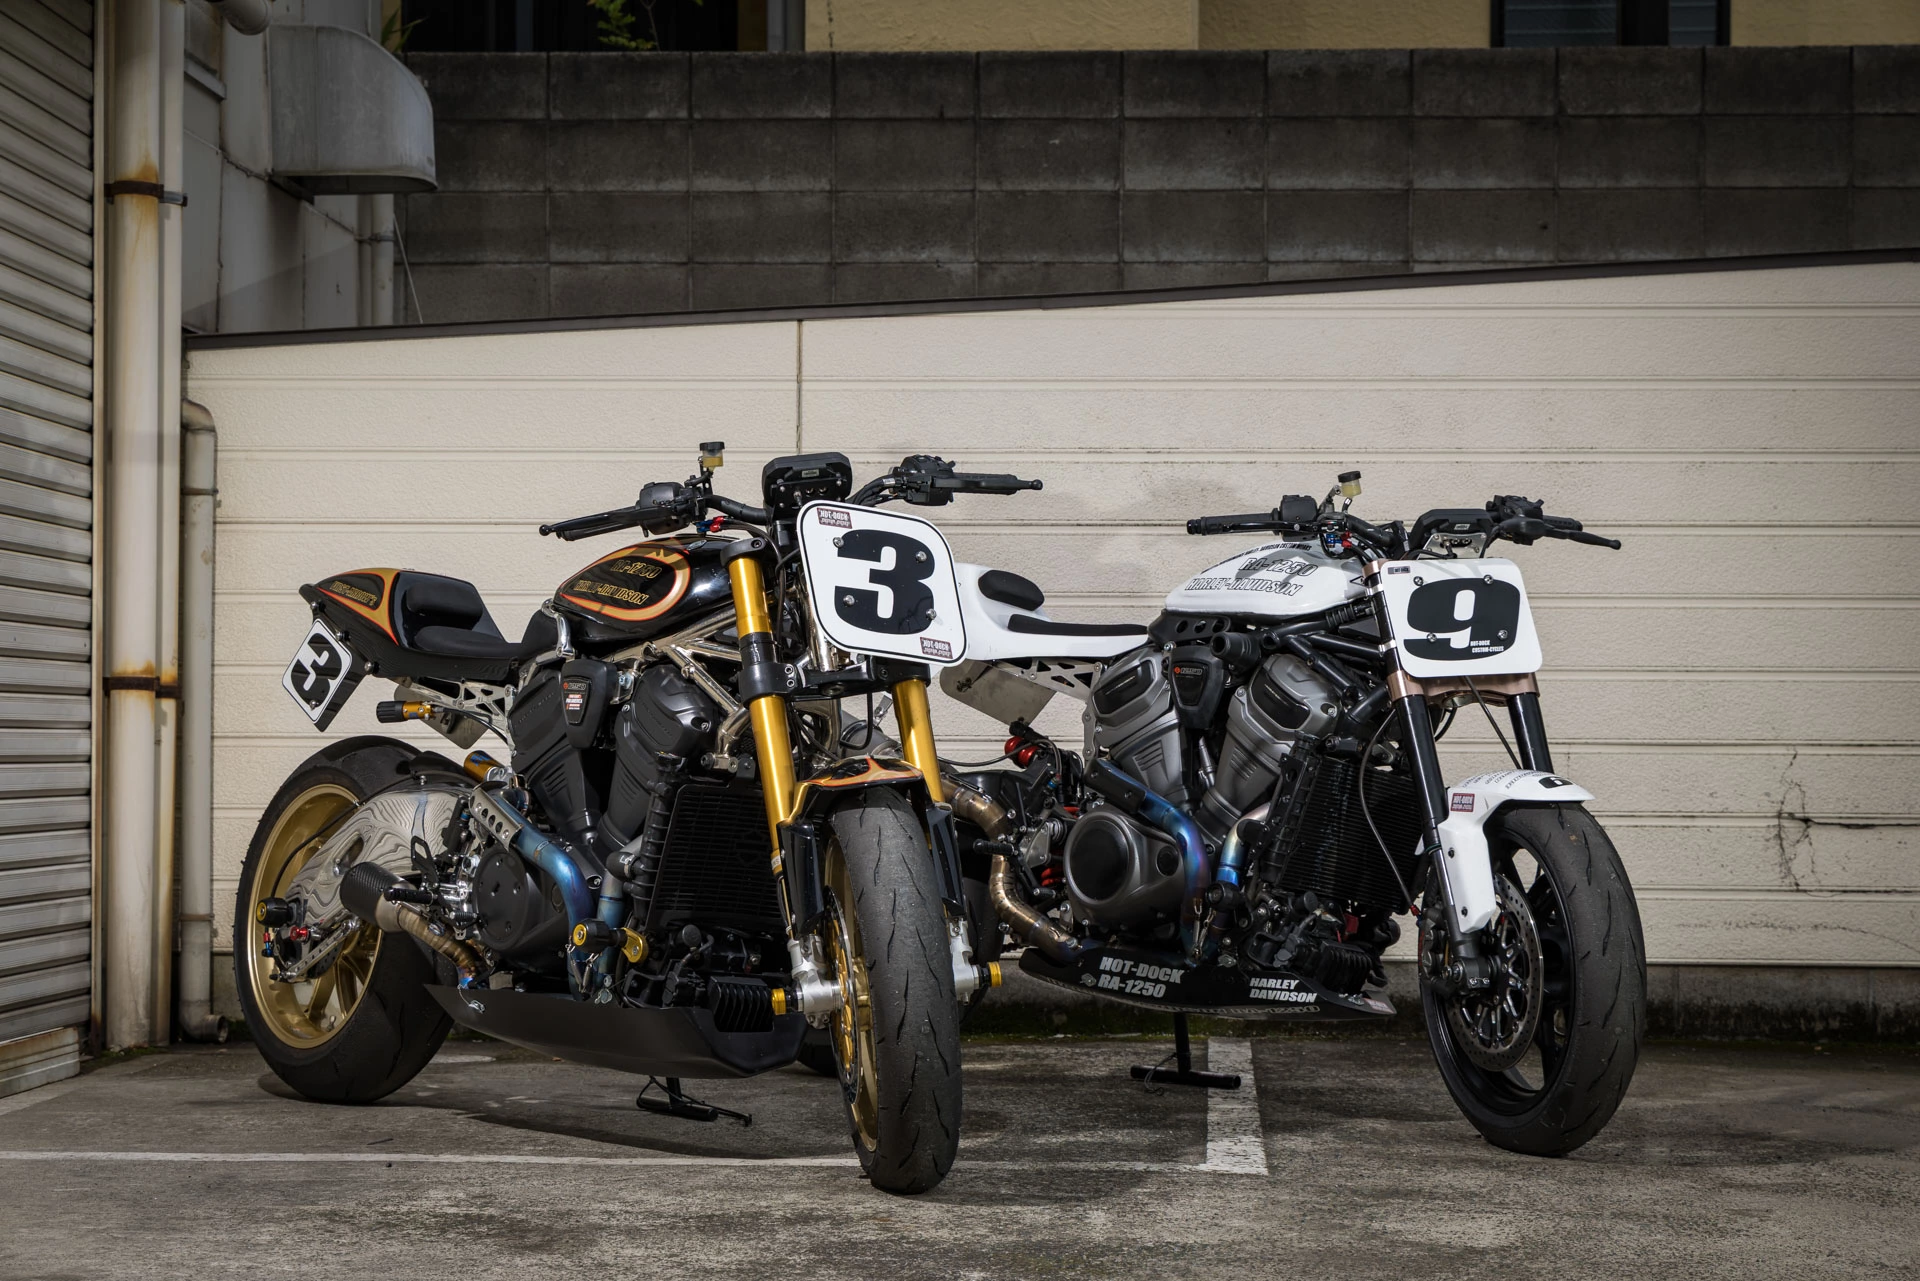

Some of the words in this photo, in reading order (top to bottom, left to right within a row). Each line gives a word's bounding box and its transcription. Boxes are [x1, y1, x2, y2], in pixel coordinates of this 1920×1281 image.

[1238, 557, 1318, 577] RA-1250
[834, 529, 936, 635] 3
[1184, 577, 1304, 597] HARLEY-DAVIDSON
[1403, 577, 1521, 661] 9
[291, 632, 342, 708] 3
[1099, 955, 1185, 984] HOT-DOCK
[1097, 972, 1167, 999] RA-1250
[1249, 977, 1300, 990] HARLEY
[1249, 988, 1318, 1003] DAVIDSON
